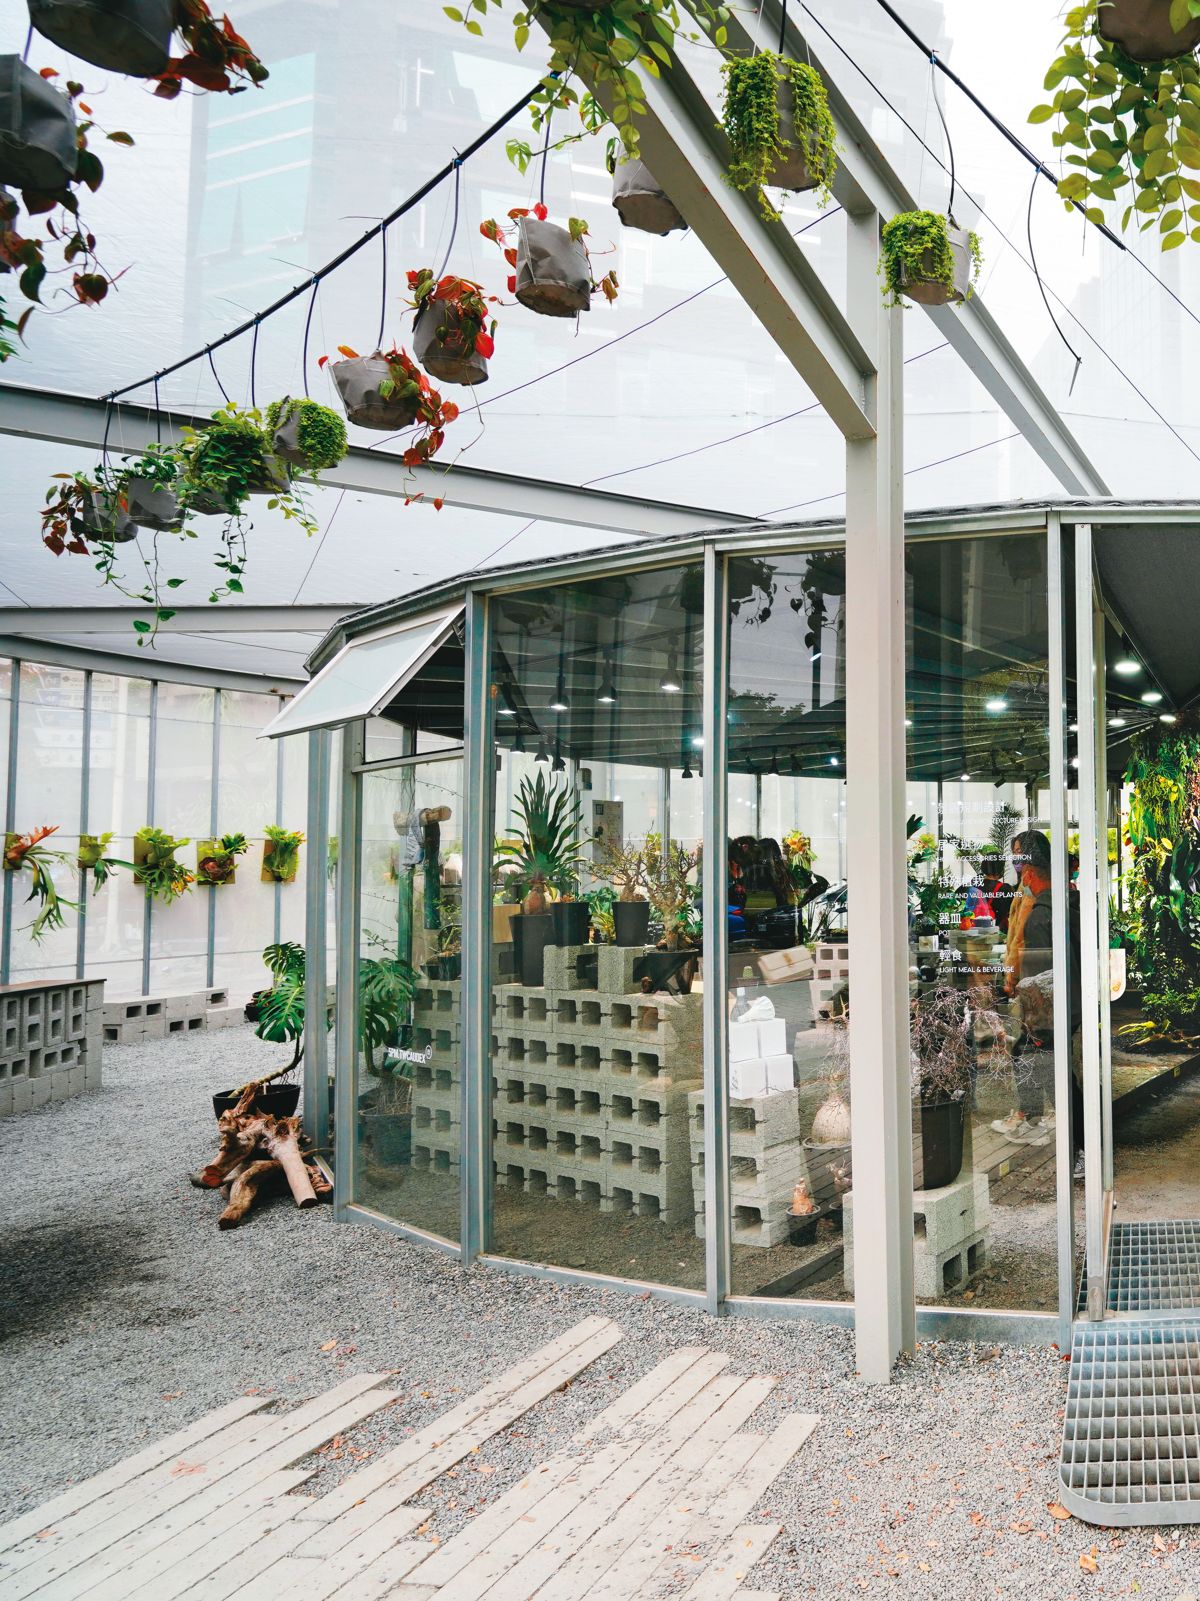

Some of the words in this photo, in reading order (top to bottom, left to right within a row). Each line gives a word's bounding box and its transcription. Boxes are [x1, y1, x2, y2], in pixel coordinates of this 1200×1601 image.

[937, 892, 954, 900] RARE
[939, 912, 962, 925] 器皿
[939, 949, 962, 961] 輕食
